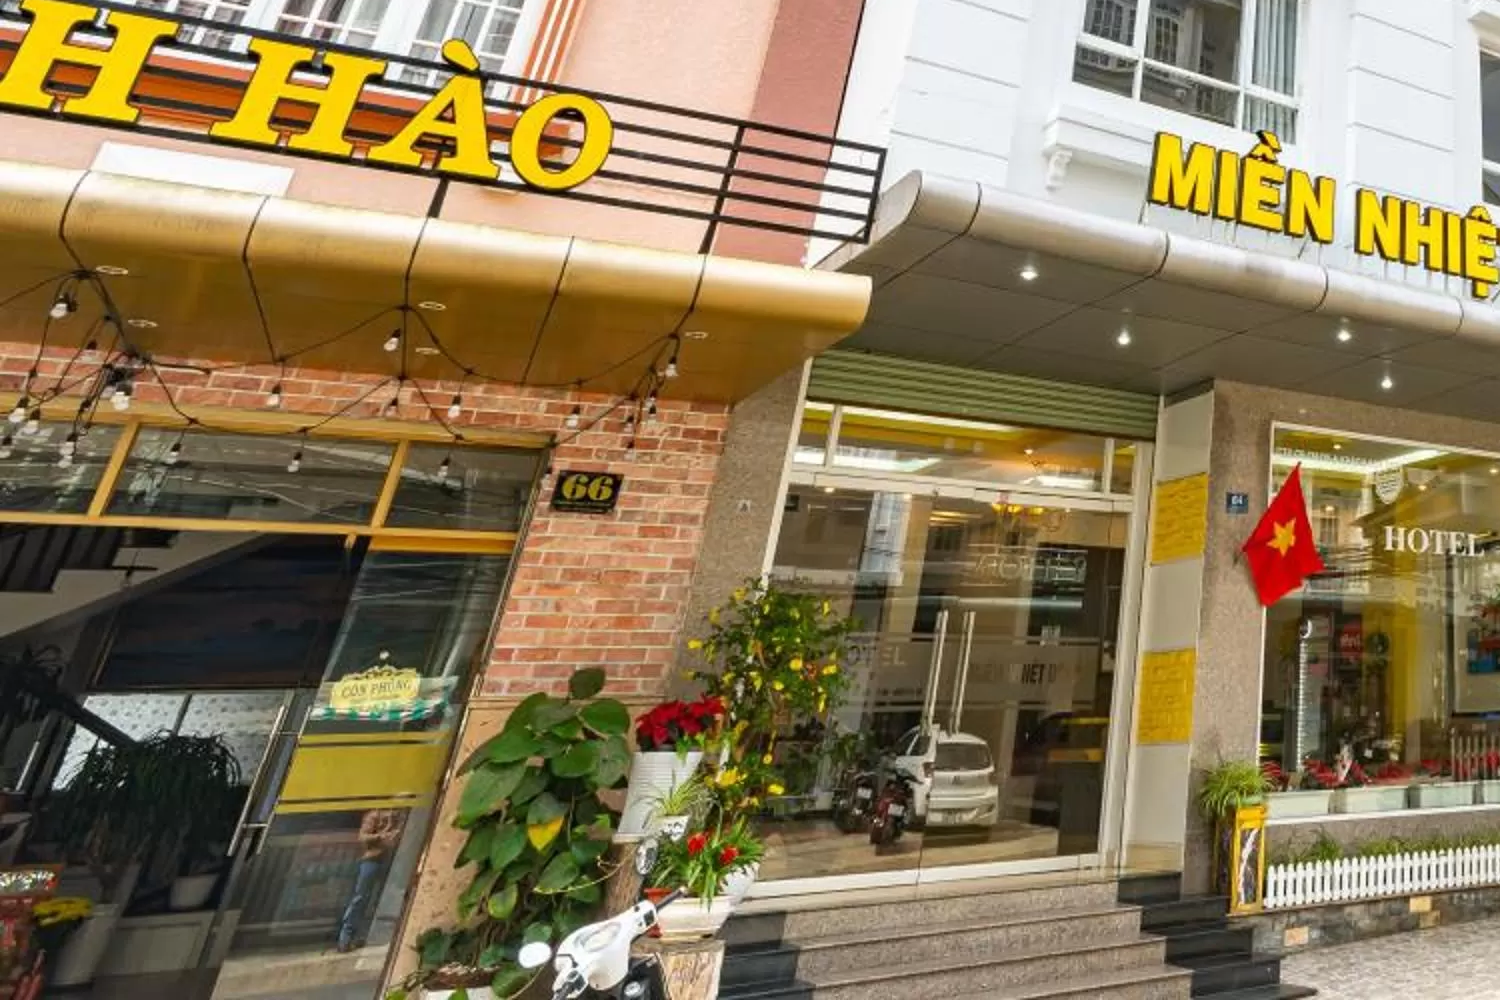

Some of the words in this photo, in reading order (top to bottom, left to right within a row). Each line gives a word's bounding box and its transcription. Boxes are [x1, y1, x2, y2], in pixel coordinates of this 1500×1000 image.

[208, 37, 613, 190] HÀO
[1149, 129, 1336, 244] MIỀN
[562, 473, 614, 501] 66
[1383, 525, 1486, 557] HOTEL
